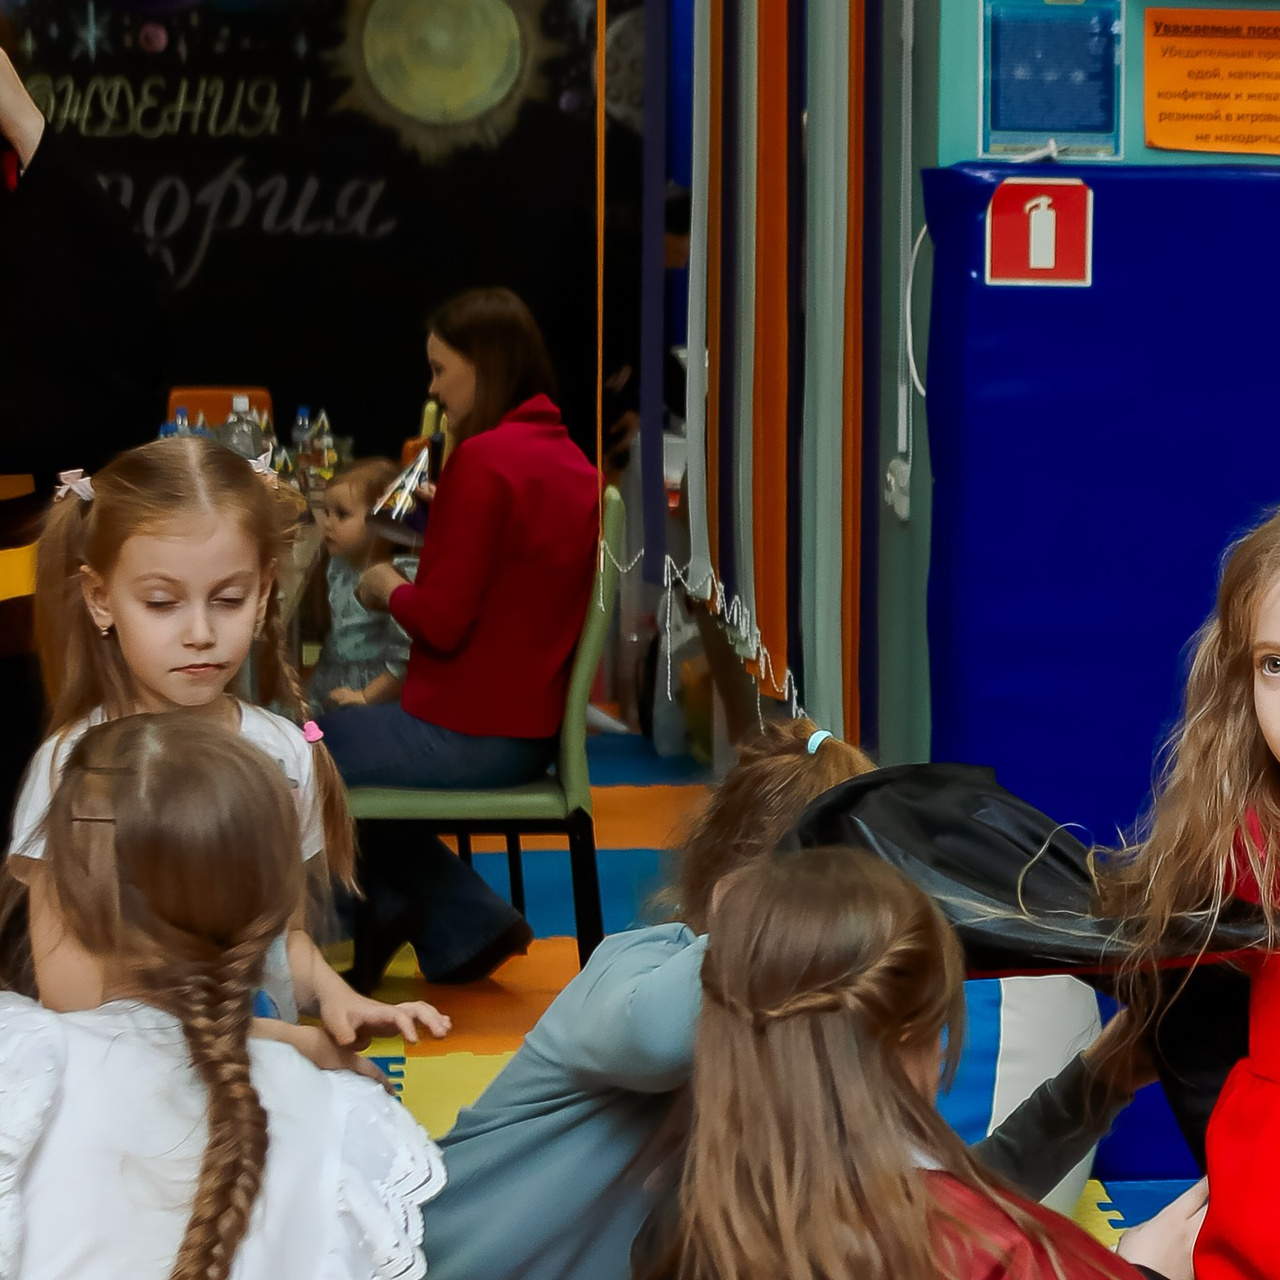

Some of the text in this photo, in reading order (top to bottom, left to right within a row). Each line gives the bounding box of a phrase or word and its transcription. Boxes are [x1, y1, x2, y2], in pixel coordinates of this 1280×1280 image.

[1153, 21, 1243, 37] Уважаемые
[1160, 46, 1254, 60] Убедительная
[1187, 68, 1223, 81] едой,
[1157, 88, 1231, 102] конфетами
[1234, 92, 1243, 100] и
[27, 73, 313, 139] ОЖДЕНИЯ!
[1158, 109, 1222, 123] резинкой
[1225, 113, 1232, 121] в
[1195, 133, 1211, 142] не
[98, 155, 400, 290] ория
